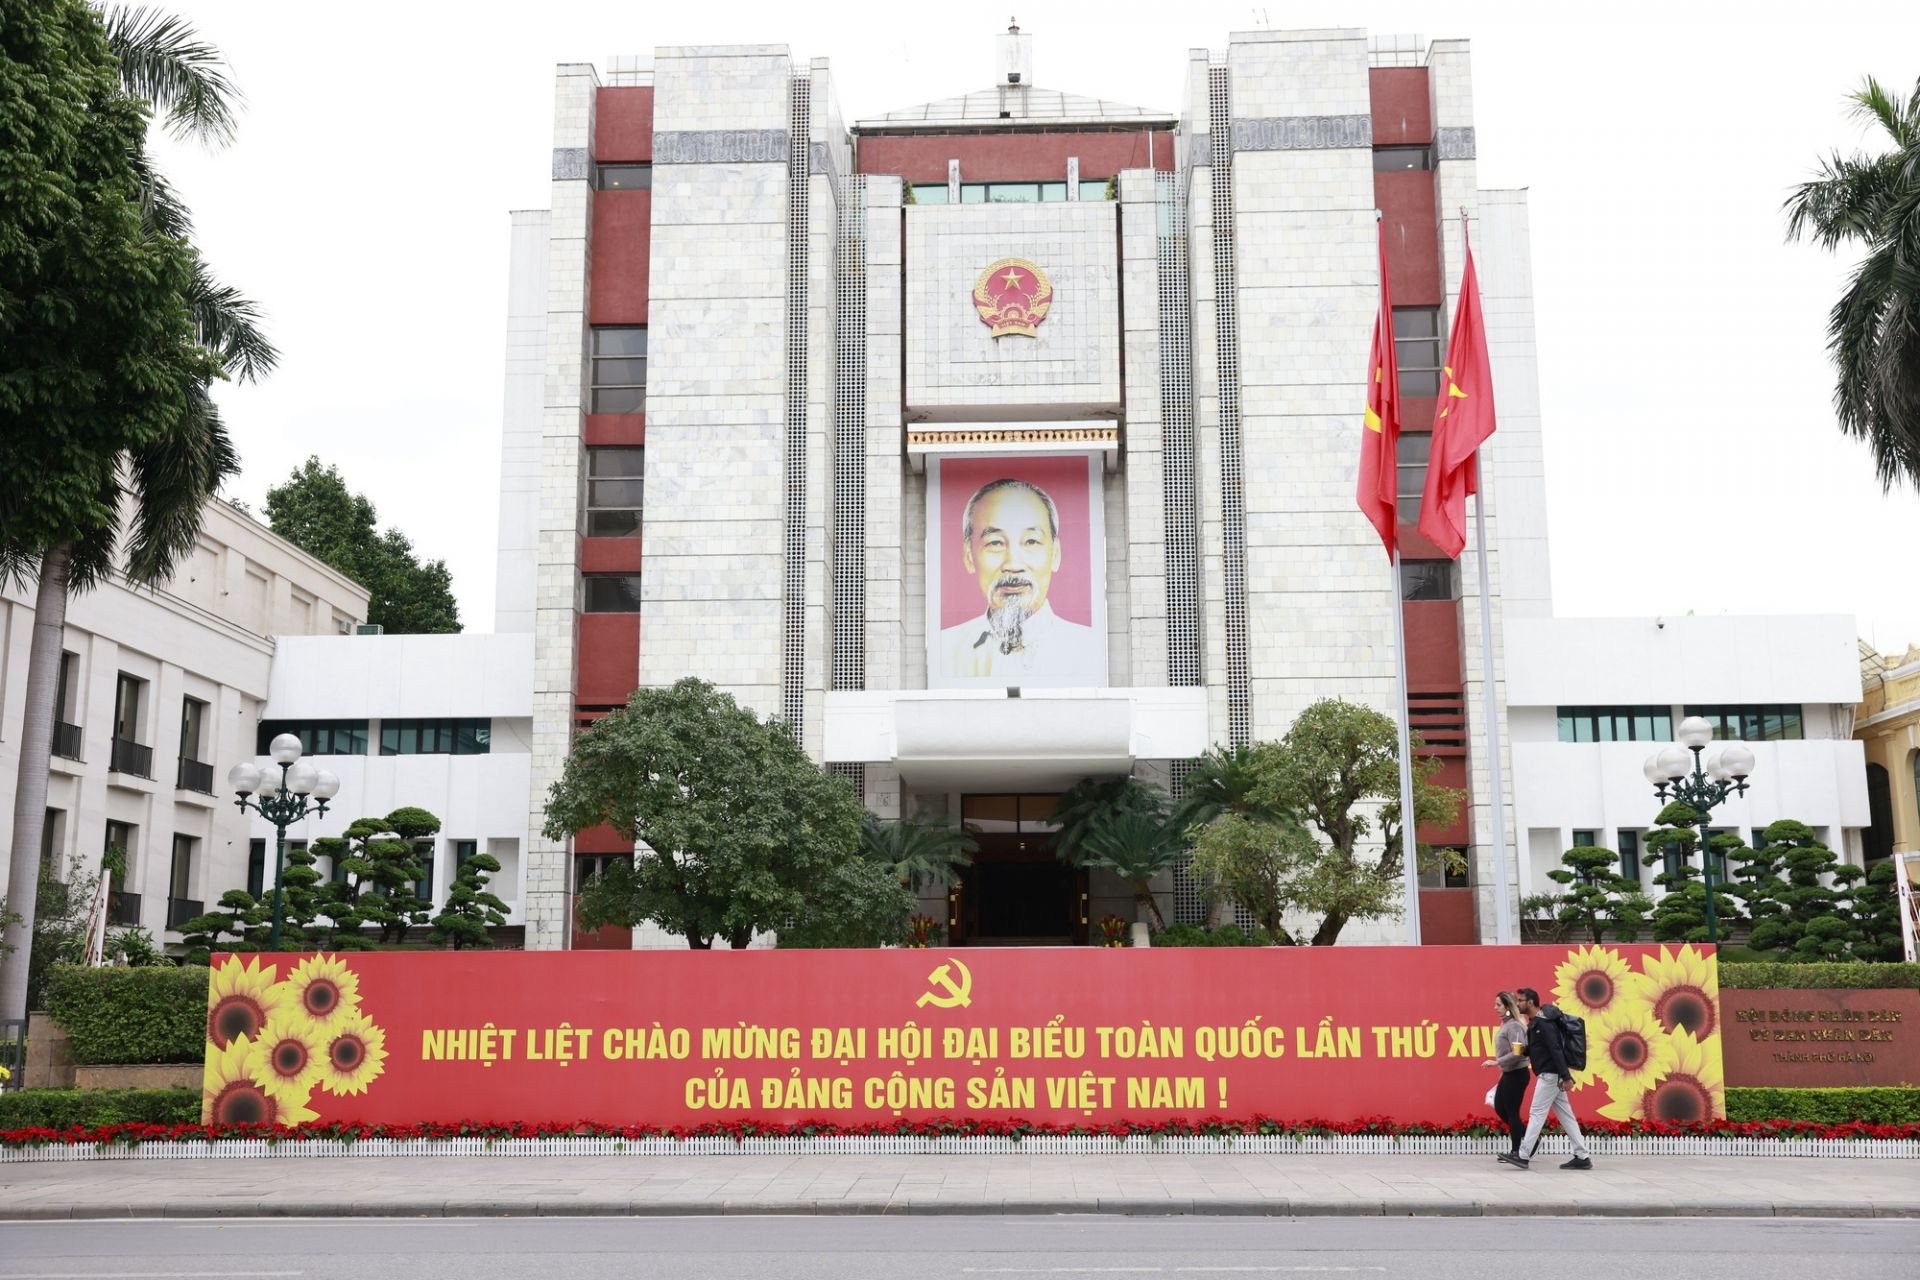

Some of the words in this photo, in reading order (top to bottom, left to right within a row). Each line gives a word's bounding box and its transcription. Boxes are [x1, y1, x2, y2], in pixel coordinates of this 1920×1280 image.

[421, 1022, 517, 1067] NHIỆT
[524, 1022, 593, 1067] LIỆT
[603, 1021, 691, 1060] CHÀO
[701, 1021, 801, 1060] MỪNG
[811, 1027, 866, 1066] ĐẠI
[877, 1020, 932, 1066] HỘI
[943, 1027, 999, 1066] ĐẠI
[1010, 1014, 1086, 1059] BIỂU
[1095, 1019, 1184, 1058] TOÀN
[1195, 1015, 1285, 1061] QUỐC
[1296, 1015, 1362, 1058] LẦN
[1371, 1019, 1440, 1058] THỨ
[685, 1066, 752, 1110] CỦA
[761, 1066, 853, 1110] ĐẢNG
[864, 1070, 955, 1116] CỘNG
[966, 1066, 1035, 1110] SẢN
[1045, 1070, 1117, 1116] VIỆT
[1126, 1076, 1206, 1109] NAM
[1218, 1076, 1228, 1109] !
